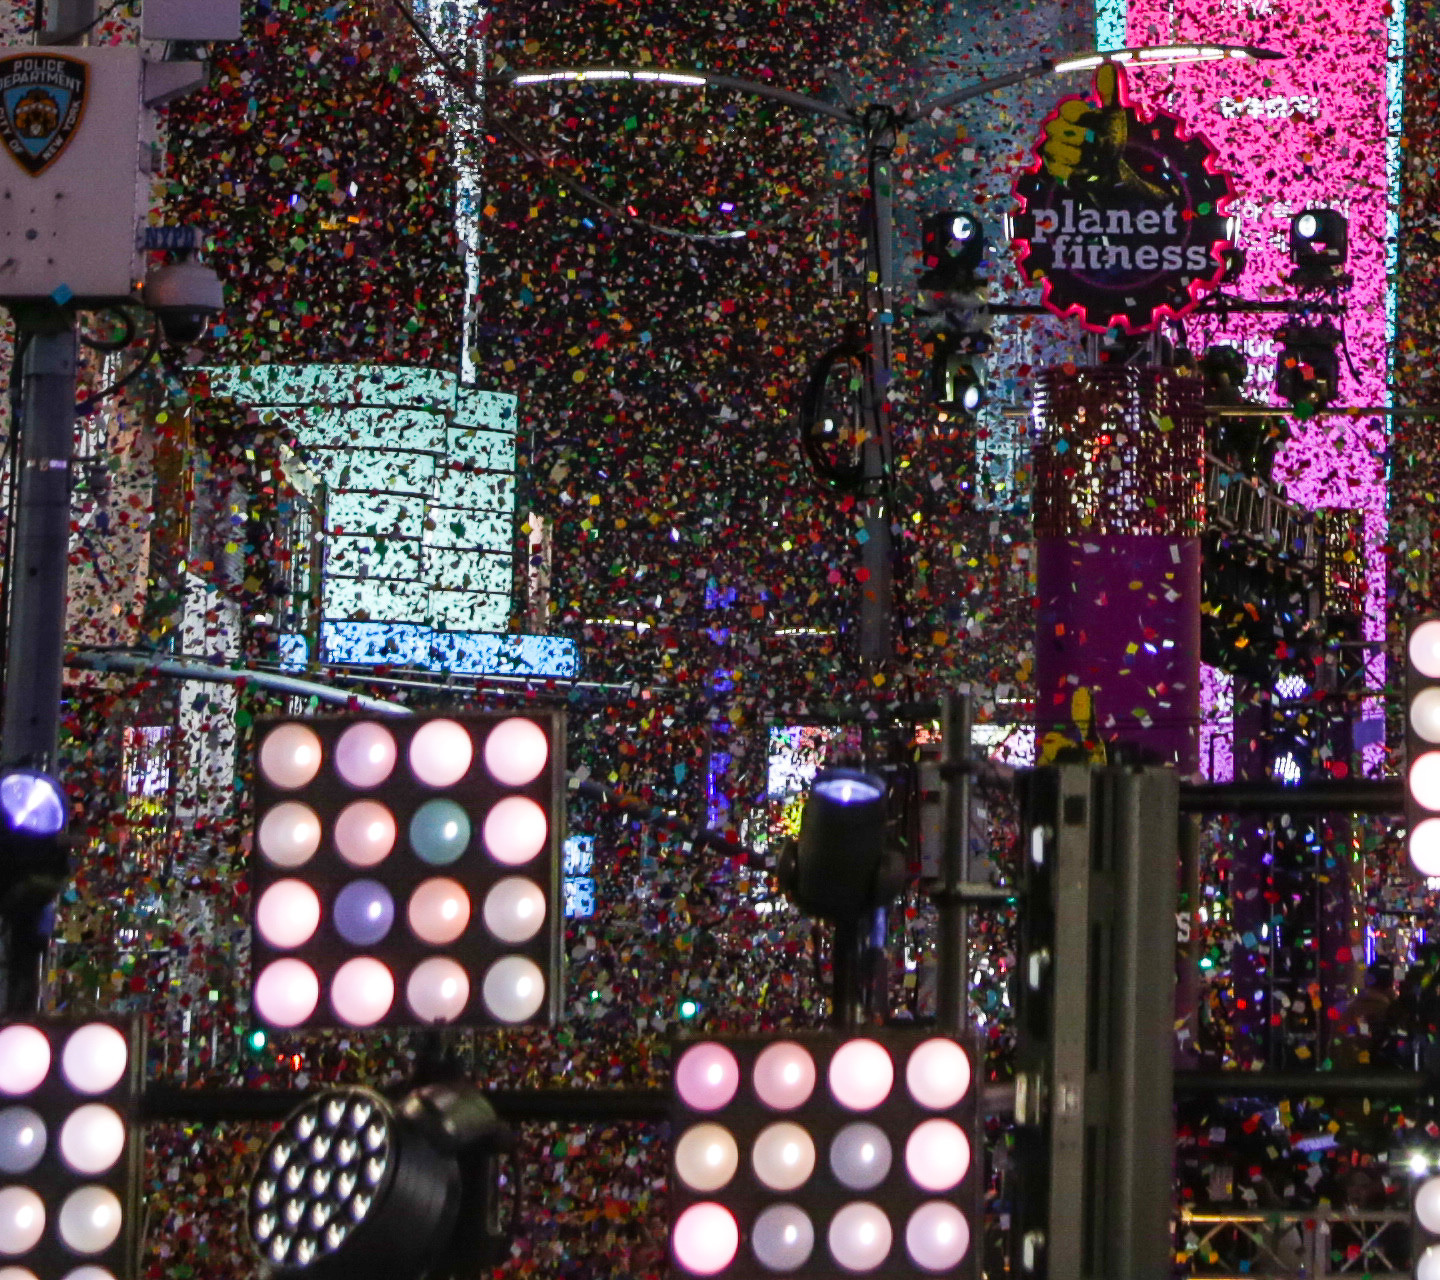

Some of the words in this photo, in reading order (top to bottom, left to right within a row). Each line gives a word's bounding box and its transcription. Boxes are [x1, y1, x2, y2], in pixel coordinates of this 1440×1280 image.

[13, 58, 66, 75] POLICE
[1030, 200, 1179, 247] planet
[1050, 236, 1209, 272] fitness
